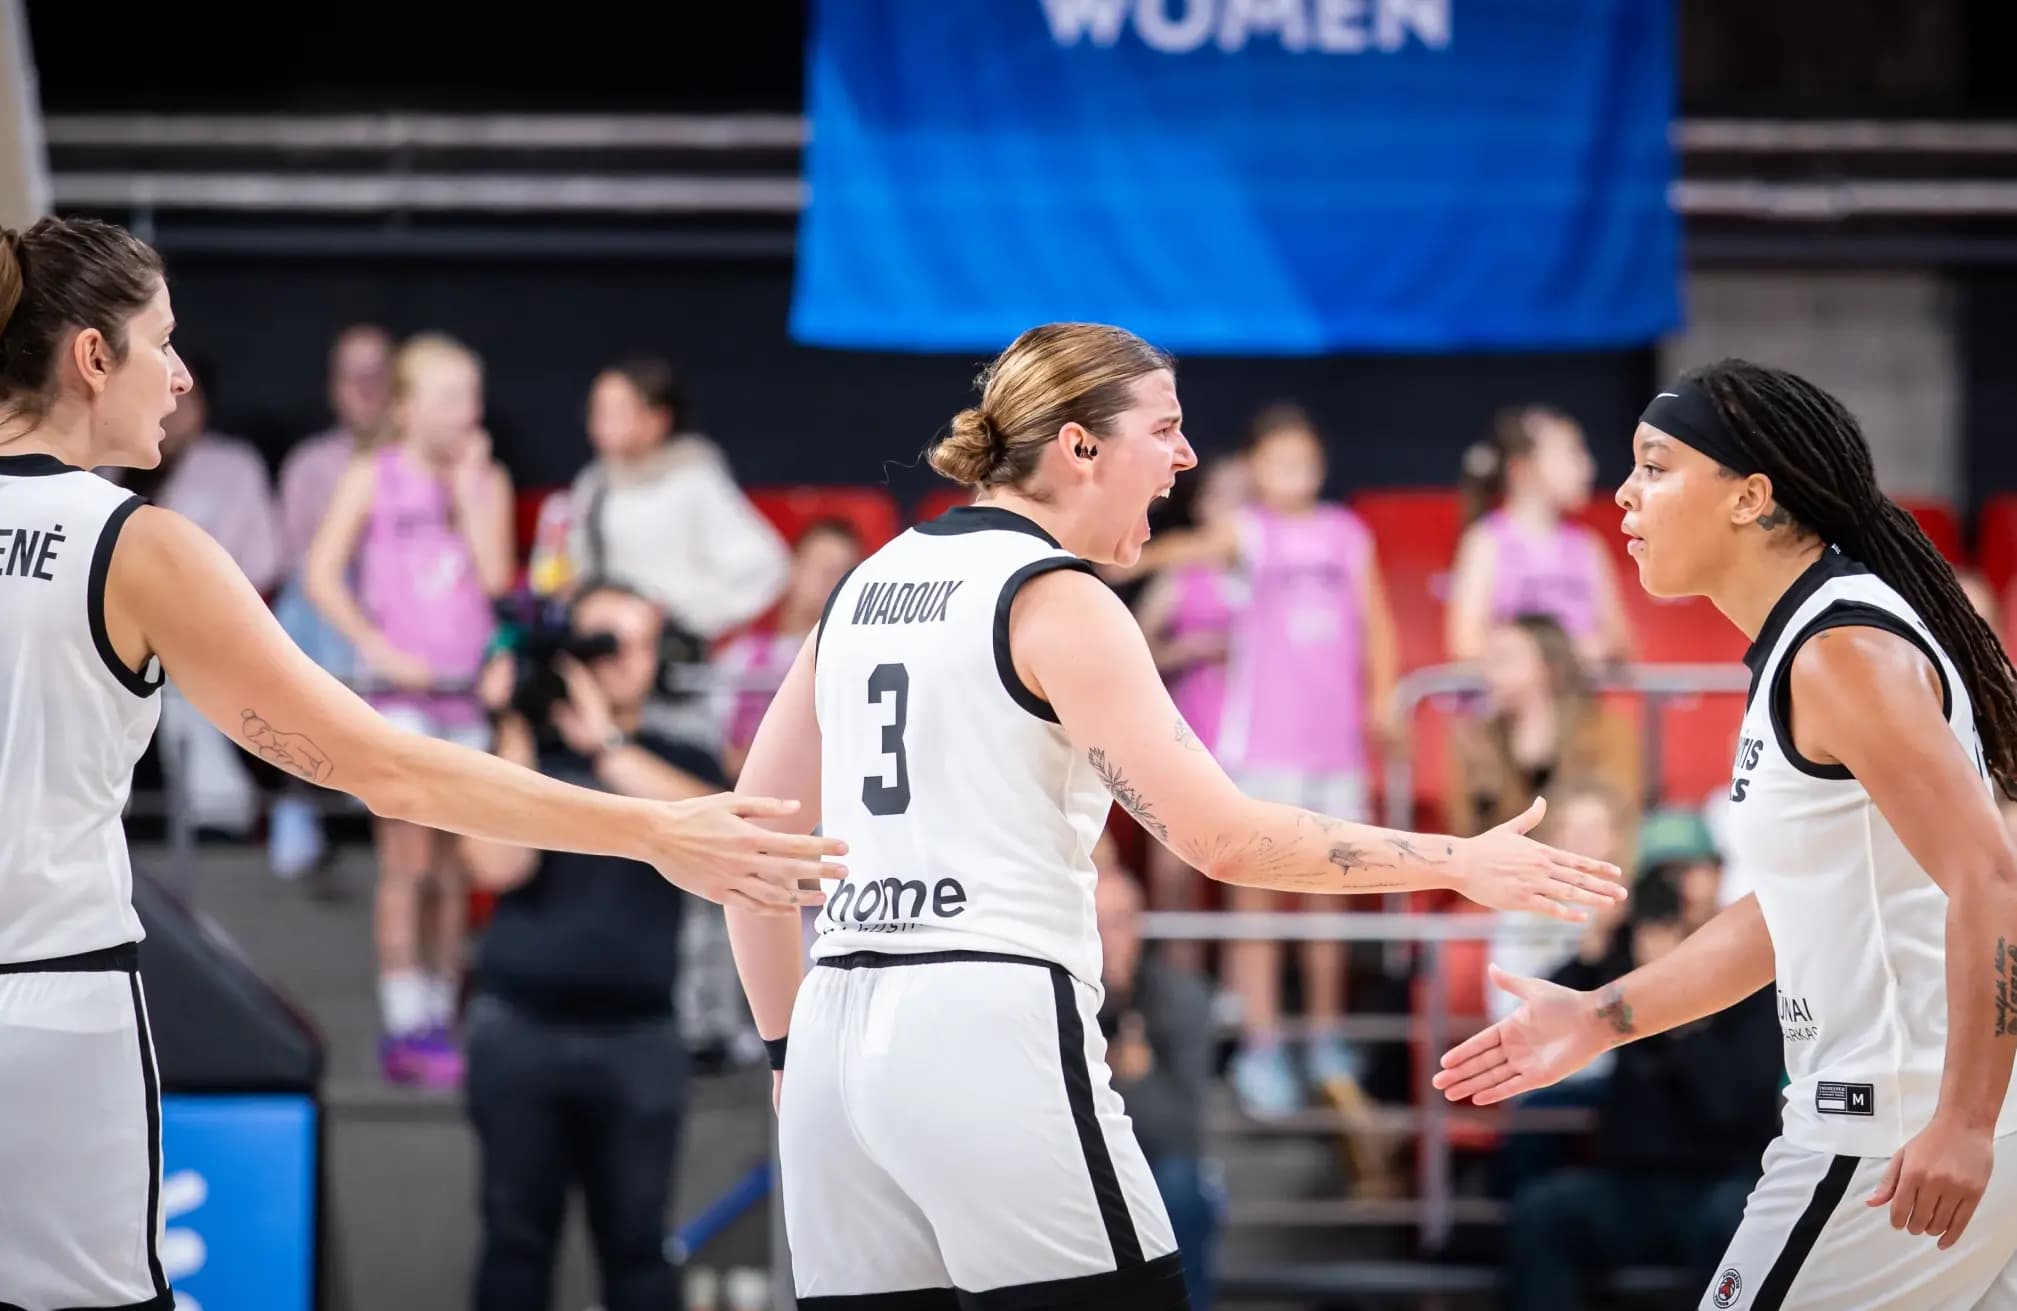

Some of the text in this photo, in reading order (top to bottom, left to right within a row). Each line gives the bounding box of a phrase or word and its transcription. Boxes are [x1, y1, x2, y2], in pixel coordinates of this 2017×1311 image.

[1039, 0, 1451, 53] WOMEN
[851, 580, 964, 625] WADOUX
[861, 662, 910, 816] 3
[827, 877, 967, 922] home
[1852, 1093, 1864, 1106] M
